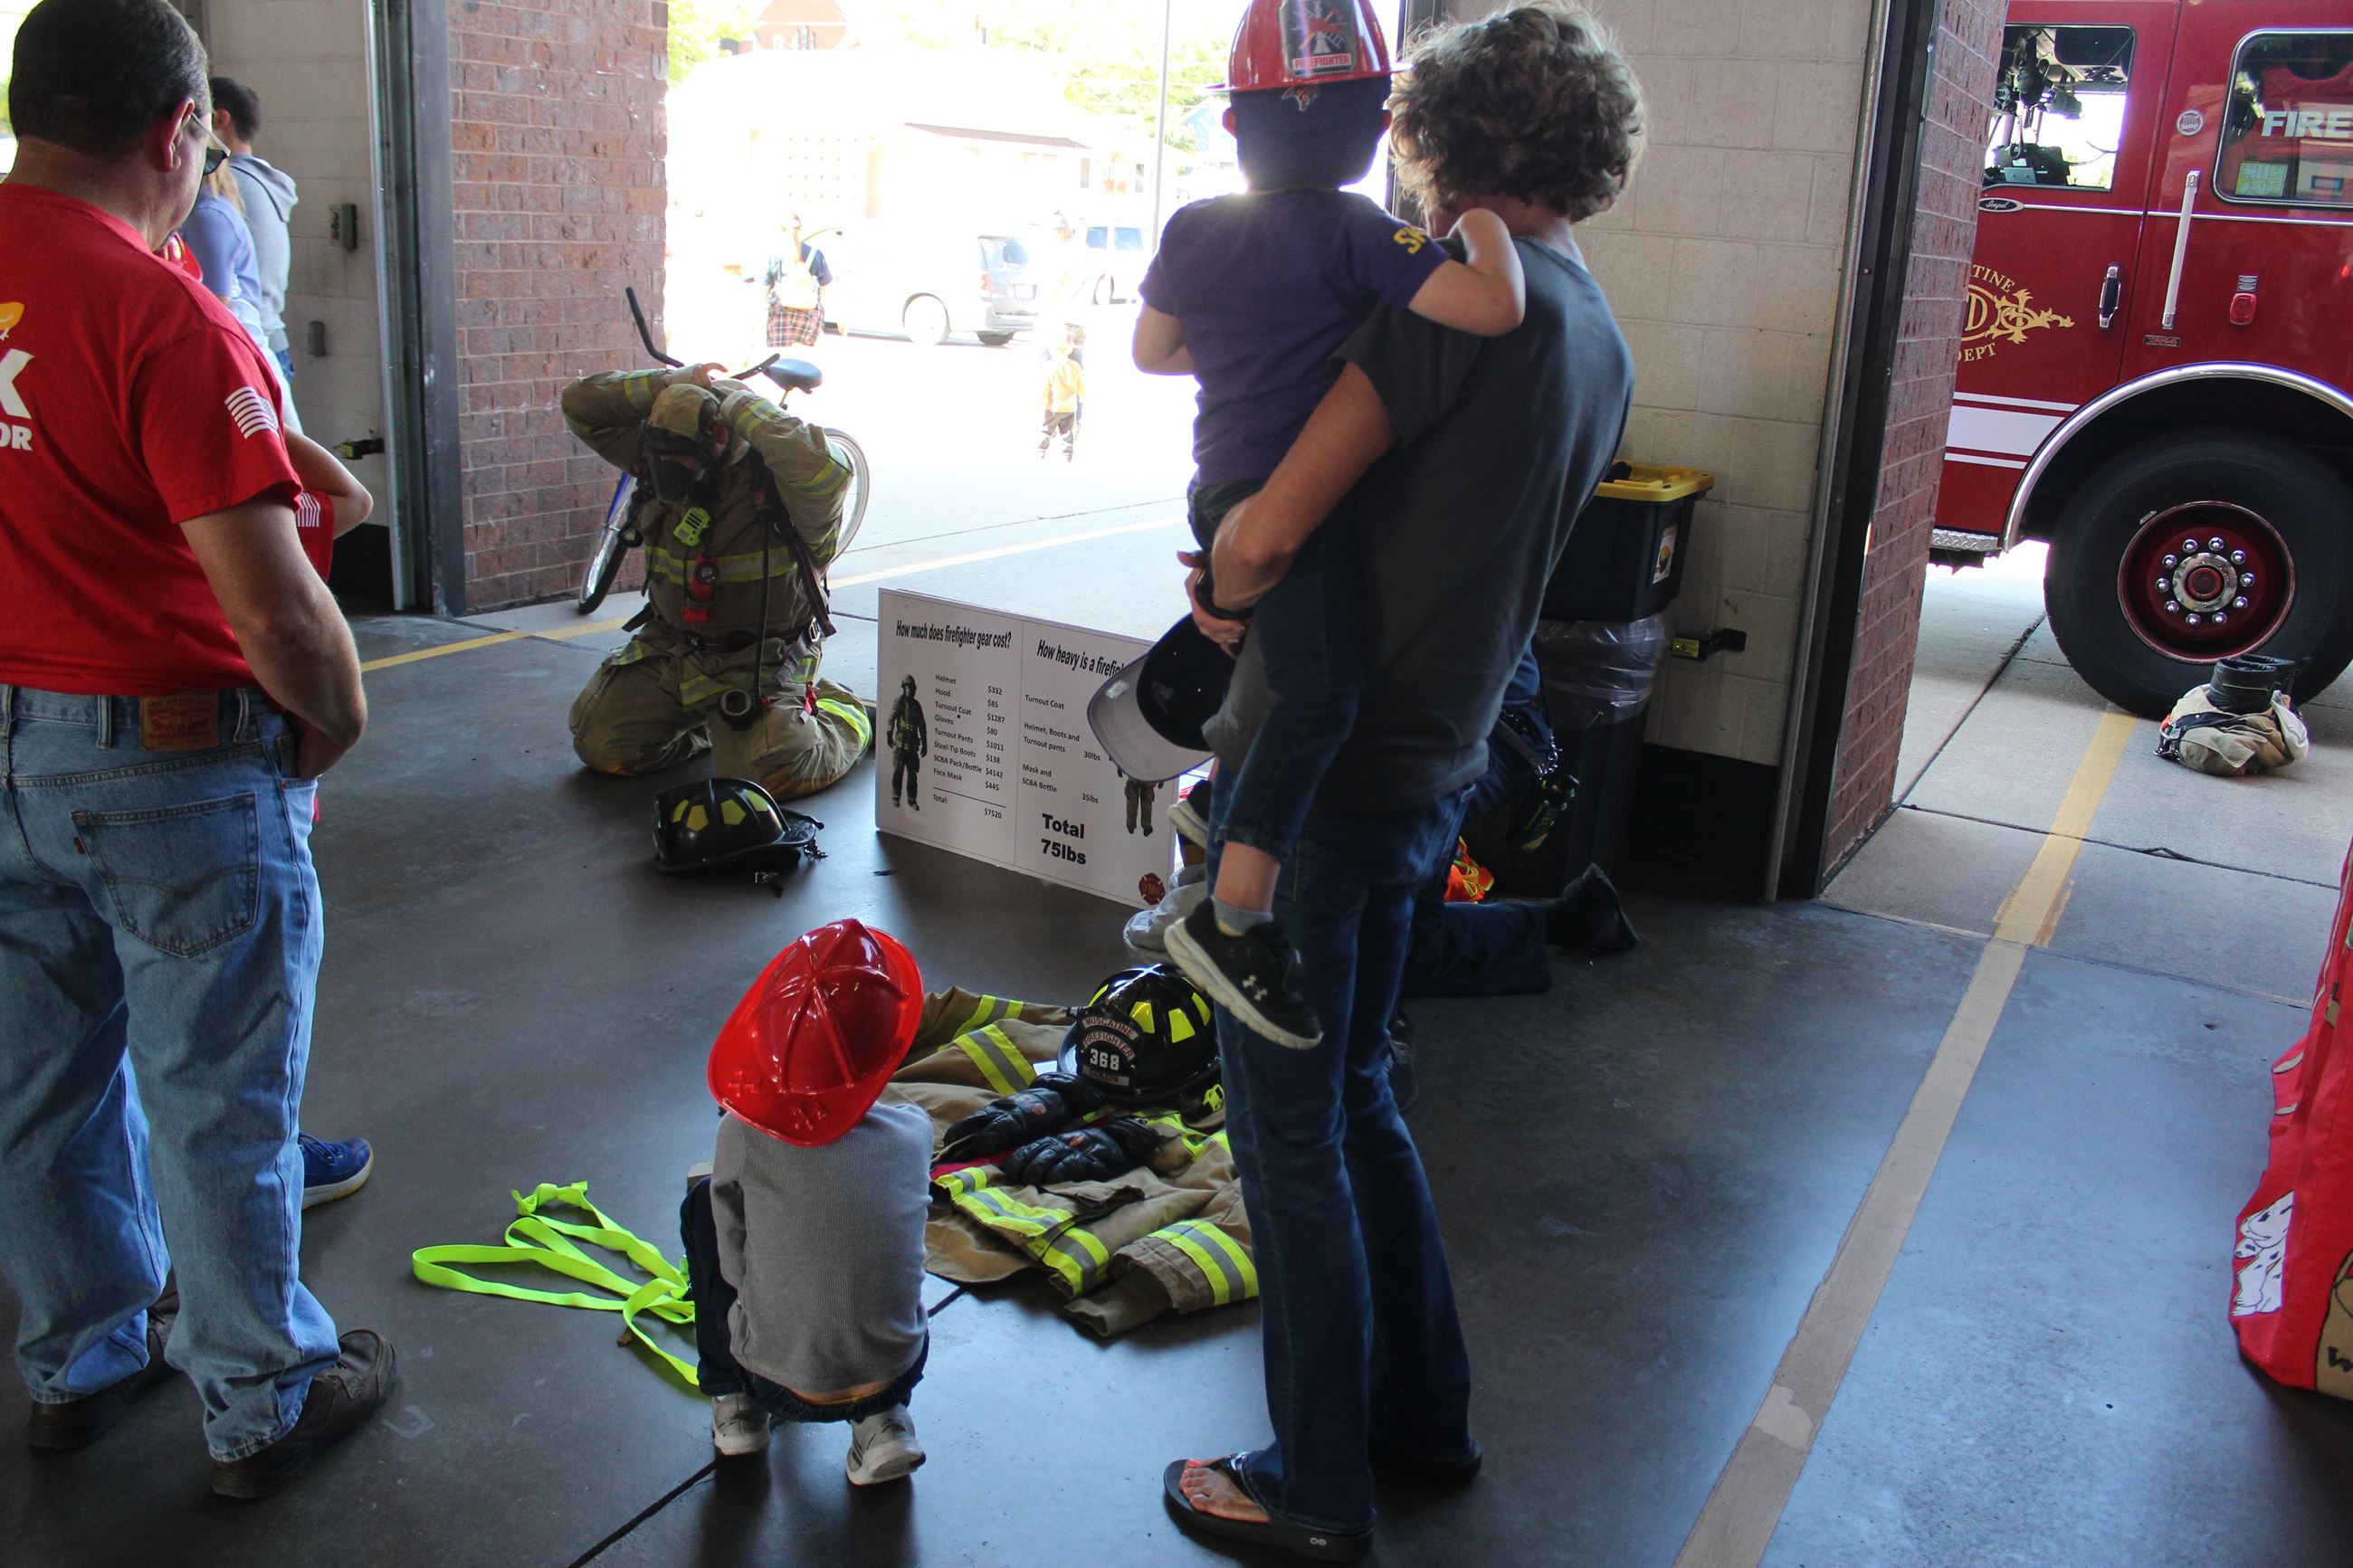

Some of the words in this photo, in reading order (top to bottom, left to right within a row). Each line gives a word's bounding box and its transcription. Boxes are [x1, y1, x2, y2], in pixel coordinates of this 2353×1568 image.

[2261, 110, 2353, 138] FIRE
[1970, 263, 2015, 293] TINE
[896, 620, 910, 637] How
[910, 622, 929, 640] much
[929, 623, 944, 641] does
[944, 624, 976, 648] firefighter
[976, 632, 993, 650] gear
[993, 632, 1012, 649] cost?
[1036, 639, 1055, 660] How
[1055, 644, 1081, 671] heavy
[1080, 651, 1089, 670] is
[1089, 659, 1095, 672] a
[935, 674, 957, 685] Helmet
[987, 685, 1003, 696] $332
[935, 688, 951, 697] Hood
[987, 699, 999, 708] $85
[1024, 694, 1049, 707] Turnout
[1050, 700, 1064, 710] Coat
[935, 700, 957, 712] Turnout
[957, 707, 972, 716] Coat
[986, 713, 1005, 724] $1287
[934, 715, 954, 725] Gloves
[986, 727, 998, 736] $80
[1024, 722, 1048, 735] Helmet,
[1049, 728, 1067, 739] Boots
[1068, 734, 1081, 742] and
[934, 727, 957, 739] Turnout
[957, 734, 974, 744] Pants
[986, 740, 1004, 751] $1011
[1024, 736, 1047, 748] Turnout
[1048, 743, 1066, 753] pants
[1083, 750, 1100, 761] 30lbs
[934, 741, 959, 754] Steel-Tip
[959, 747, 976, 757] Boots
[986, 754, 1001, 764] $138
[933, 755, 948, 765] SCBA
[949, 758, 982, 773] Pack/Bottle
[986, 767, 1004, 779] $4142
[1022, 764, 1040, 774] Mask
[1040, 769, 1052, 777] and
[933, 767, 946, 777] Face
[947, 771, 963, 781] Mask
[985, 781, 999, 792] $445
[1022, 777, 1038, 788] SCBA
[1038, 782, 1057, 793] Bottle
[1081, 793, 1099, 803] 35lbs
[933, 794, 948, 804] Total:
[984, 807, 1002, 819] $7520
[1042, 813, 1085, 840] Total
[1041, 838, 1087, 865] 75lbs
[1085, 1016, 1134, 1038] MUSCATINE
[1083, 1031, 1133, 1058] FIREFIGHTER
[1090, 1048, 1119, 1071] 368
